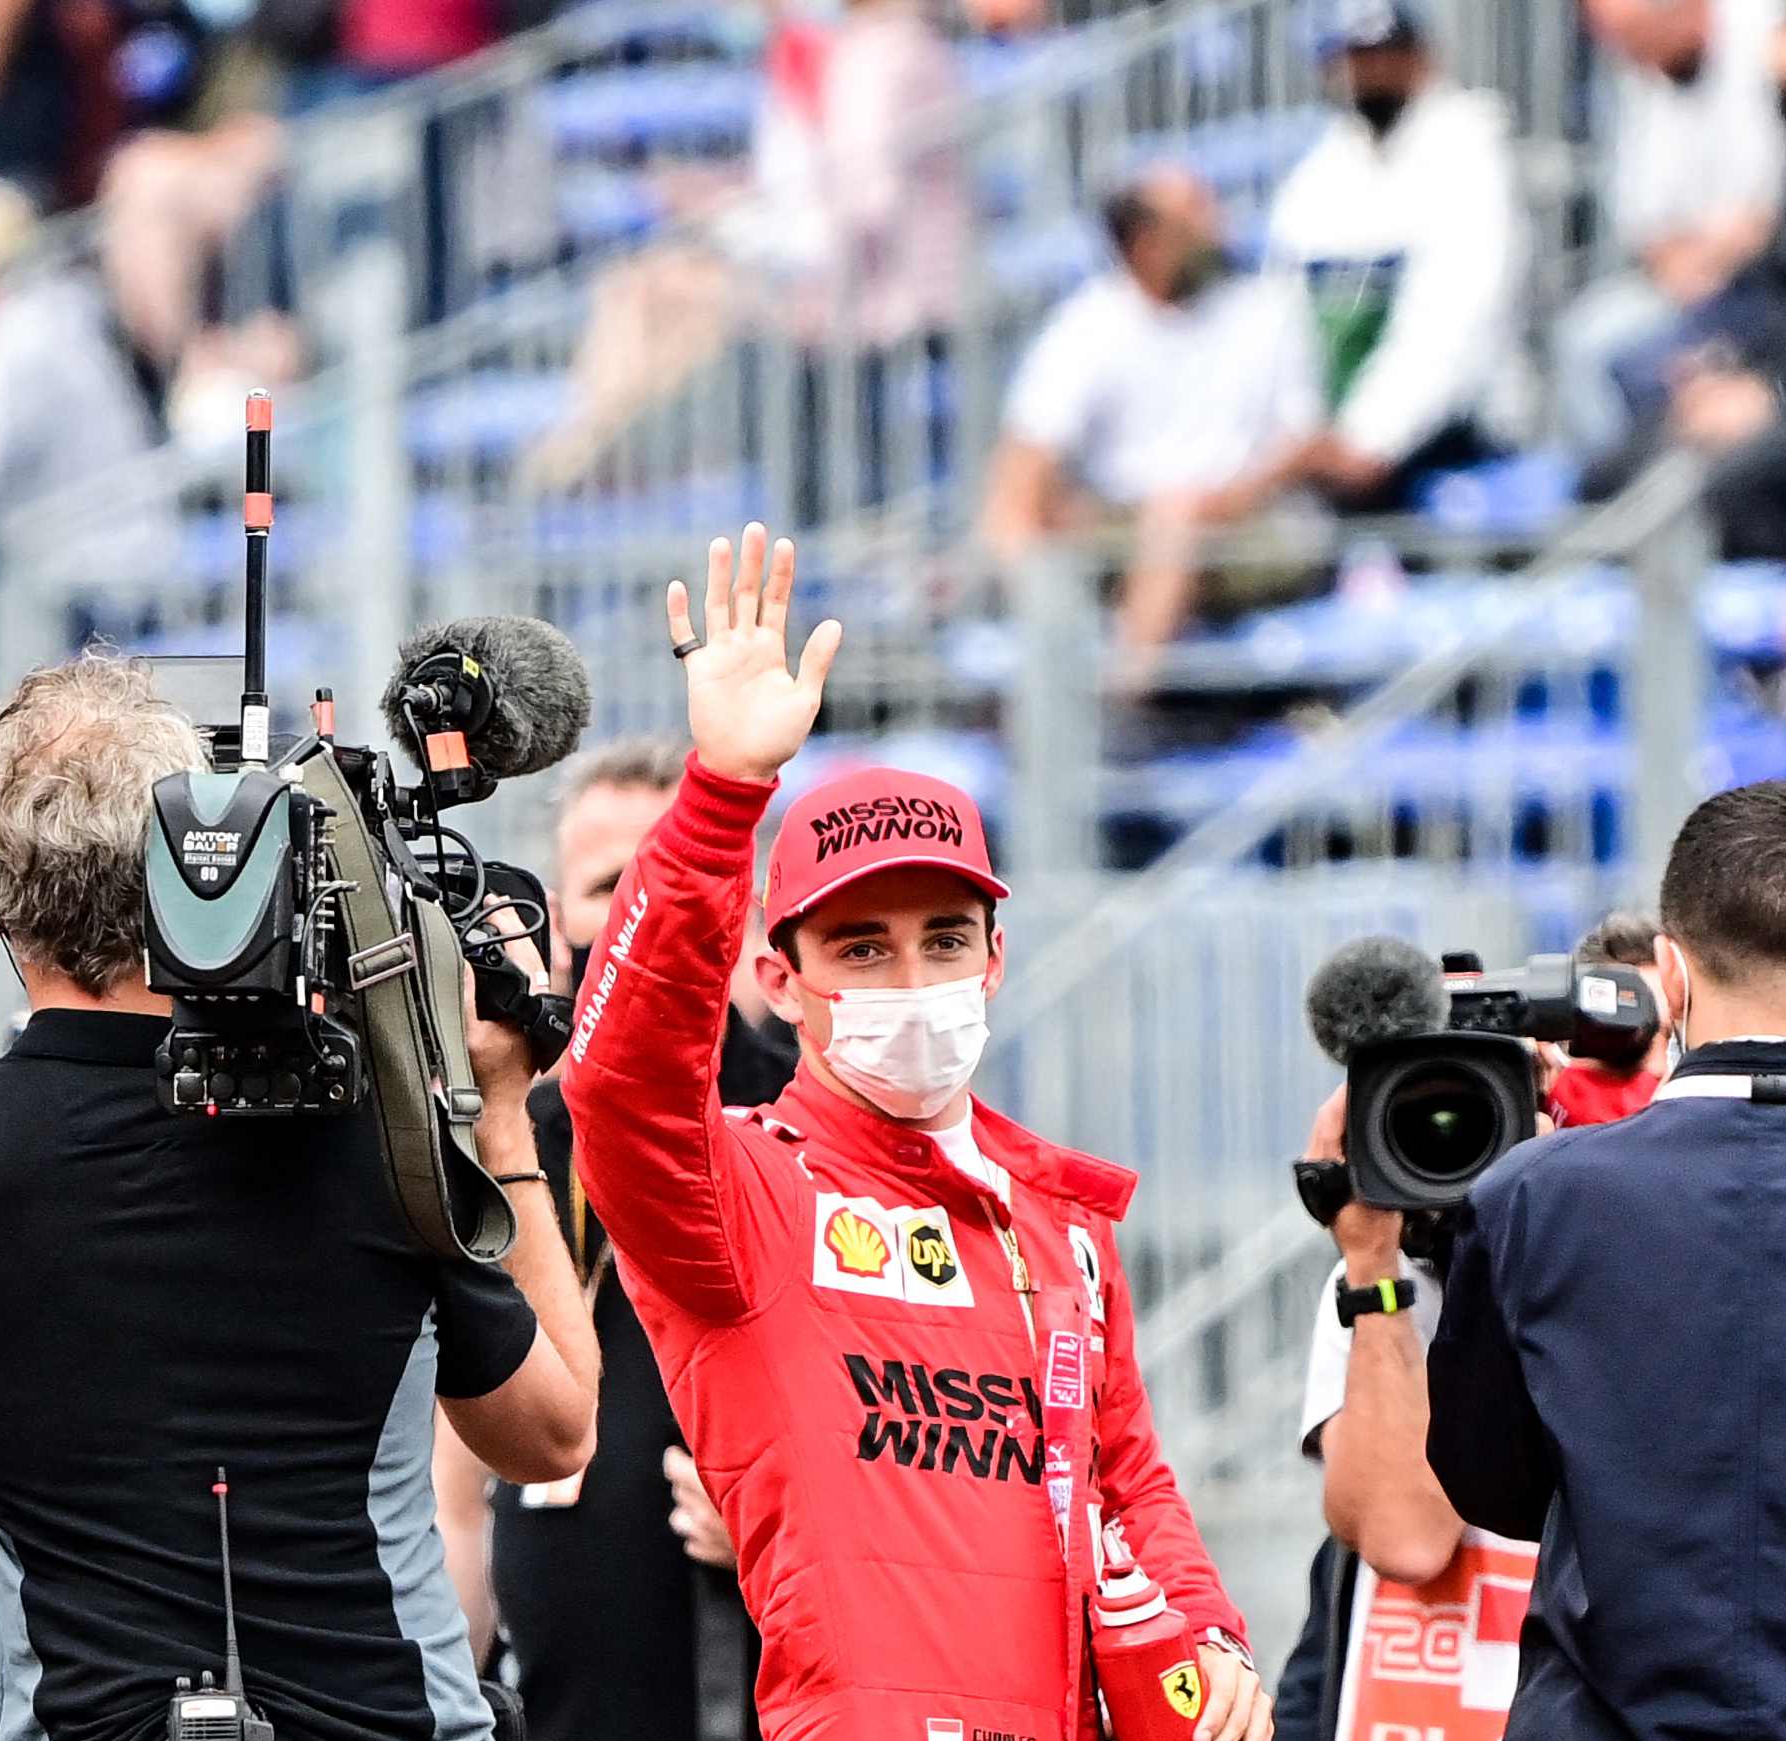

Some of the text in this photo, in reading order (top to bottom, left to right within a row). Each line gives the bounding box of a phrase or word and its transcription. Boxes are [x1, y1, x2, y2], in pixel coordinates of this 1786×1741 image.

[810, 796, 961, 837] MISSION
[816, 818, 963, 863] WINNOW
[571, 960, 619, 1064] RICHARD
[842, 1353, 1043, 1430] MISSI
[855, 1412, 1044, 1485] WINN
